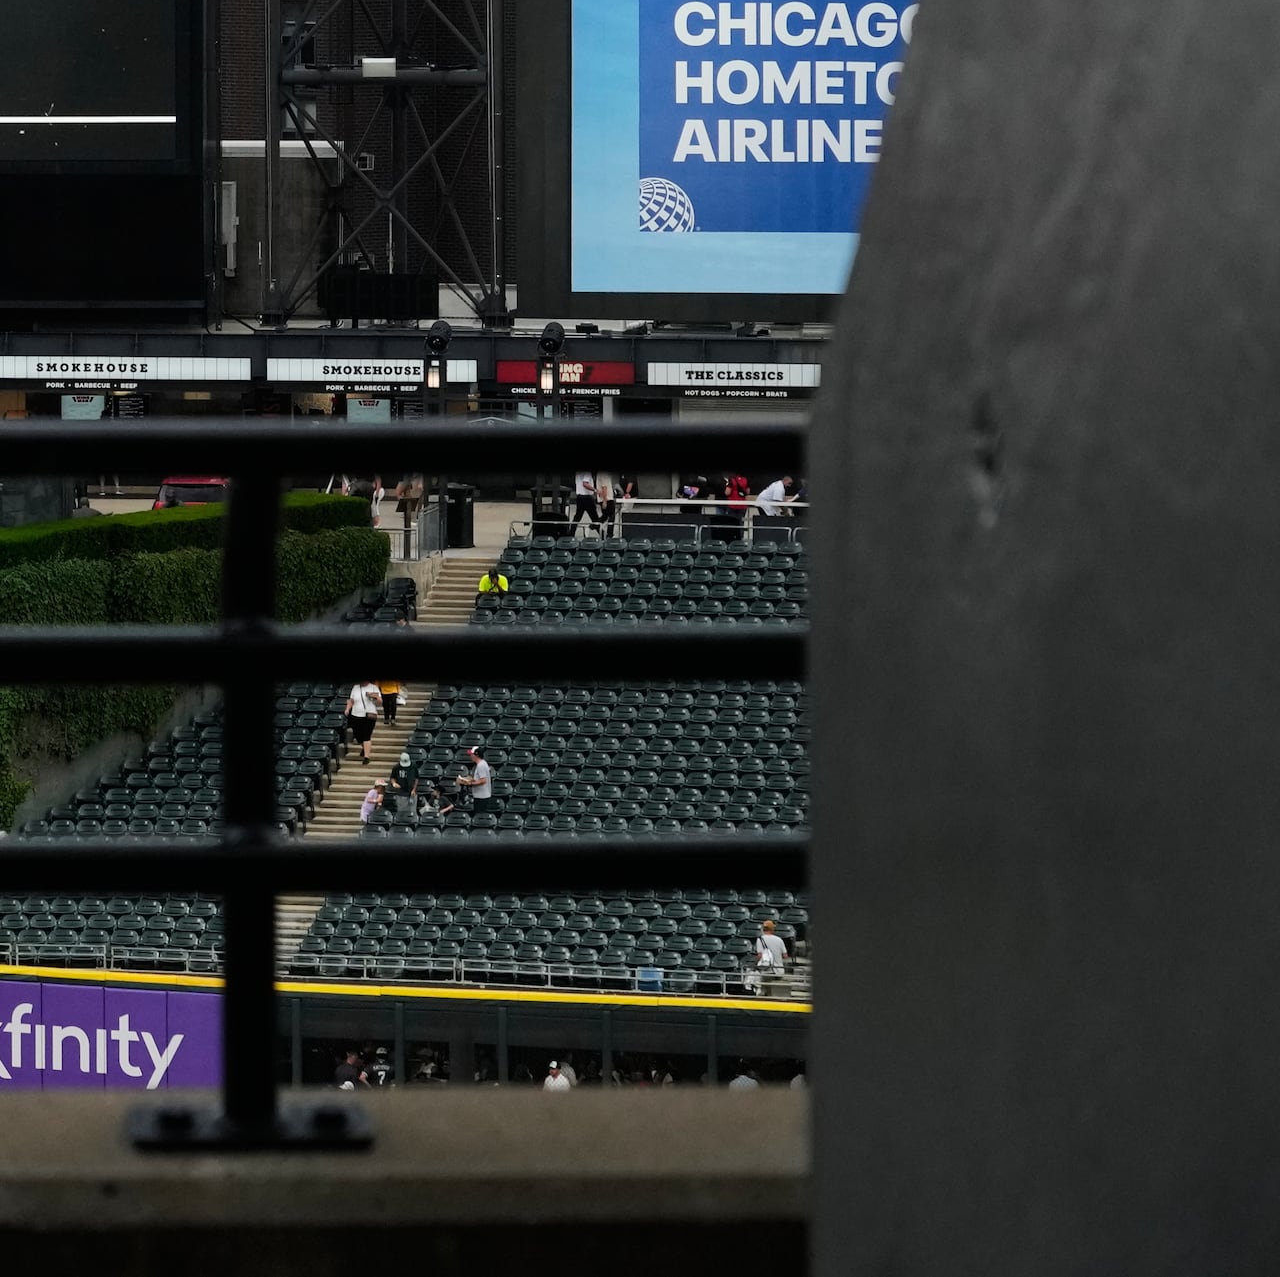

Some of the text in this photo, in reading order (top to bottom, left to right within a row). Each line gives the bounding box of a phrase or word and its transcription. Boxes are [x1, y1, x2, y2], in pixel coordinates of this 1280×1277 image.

[36, 363, 148, 372] SMOKEHOUSE
[322, 365, 421, 375] SMOKEHOUSE
[559, 363, 583, 373] ING
[559, 373, 580, 382] AN
[685, 370, 784, 381] THE CLASSICS
